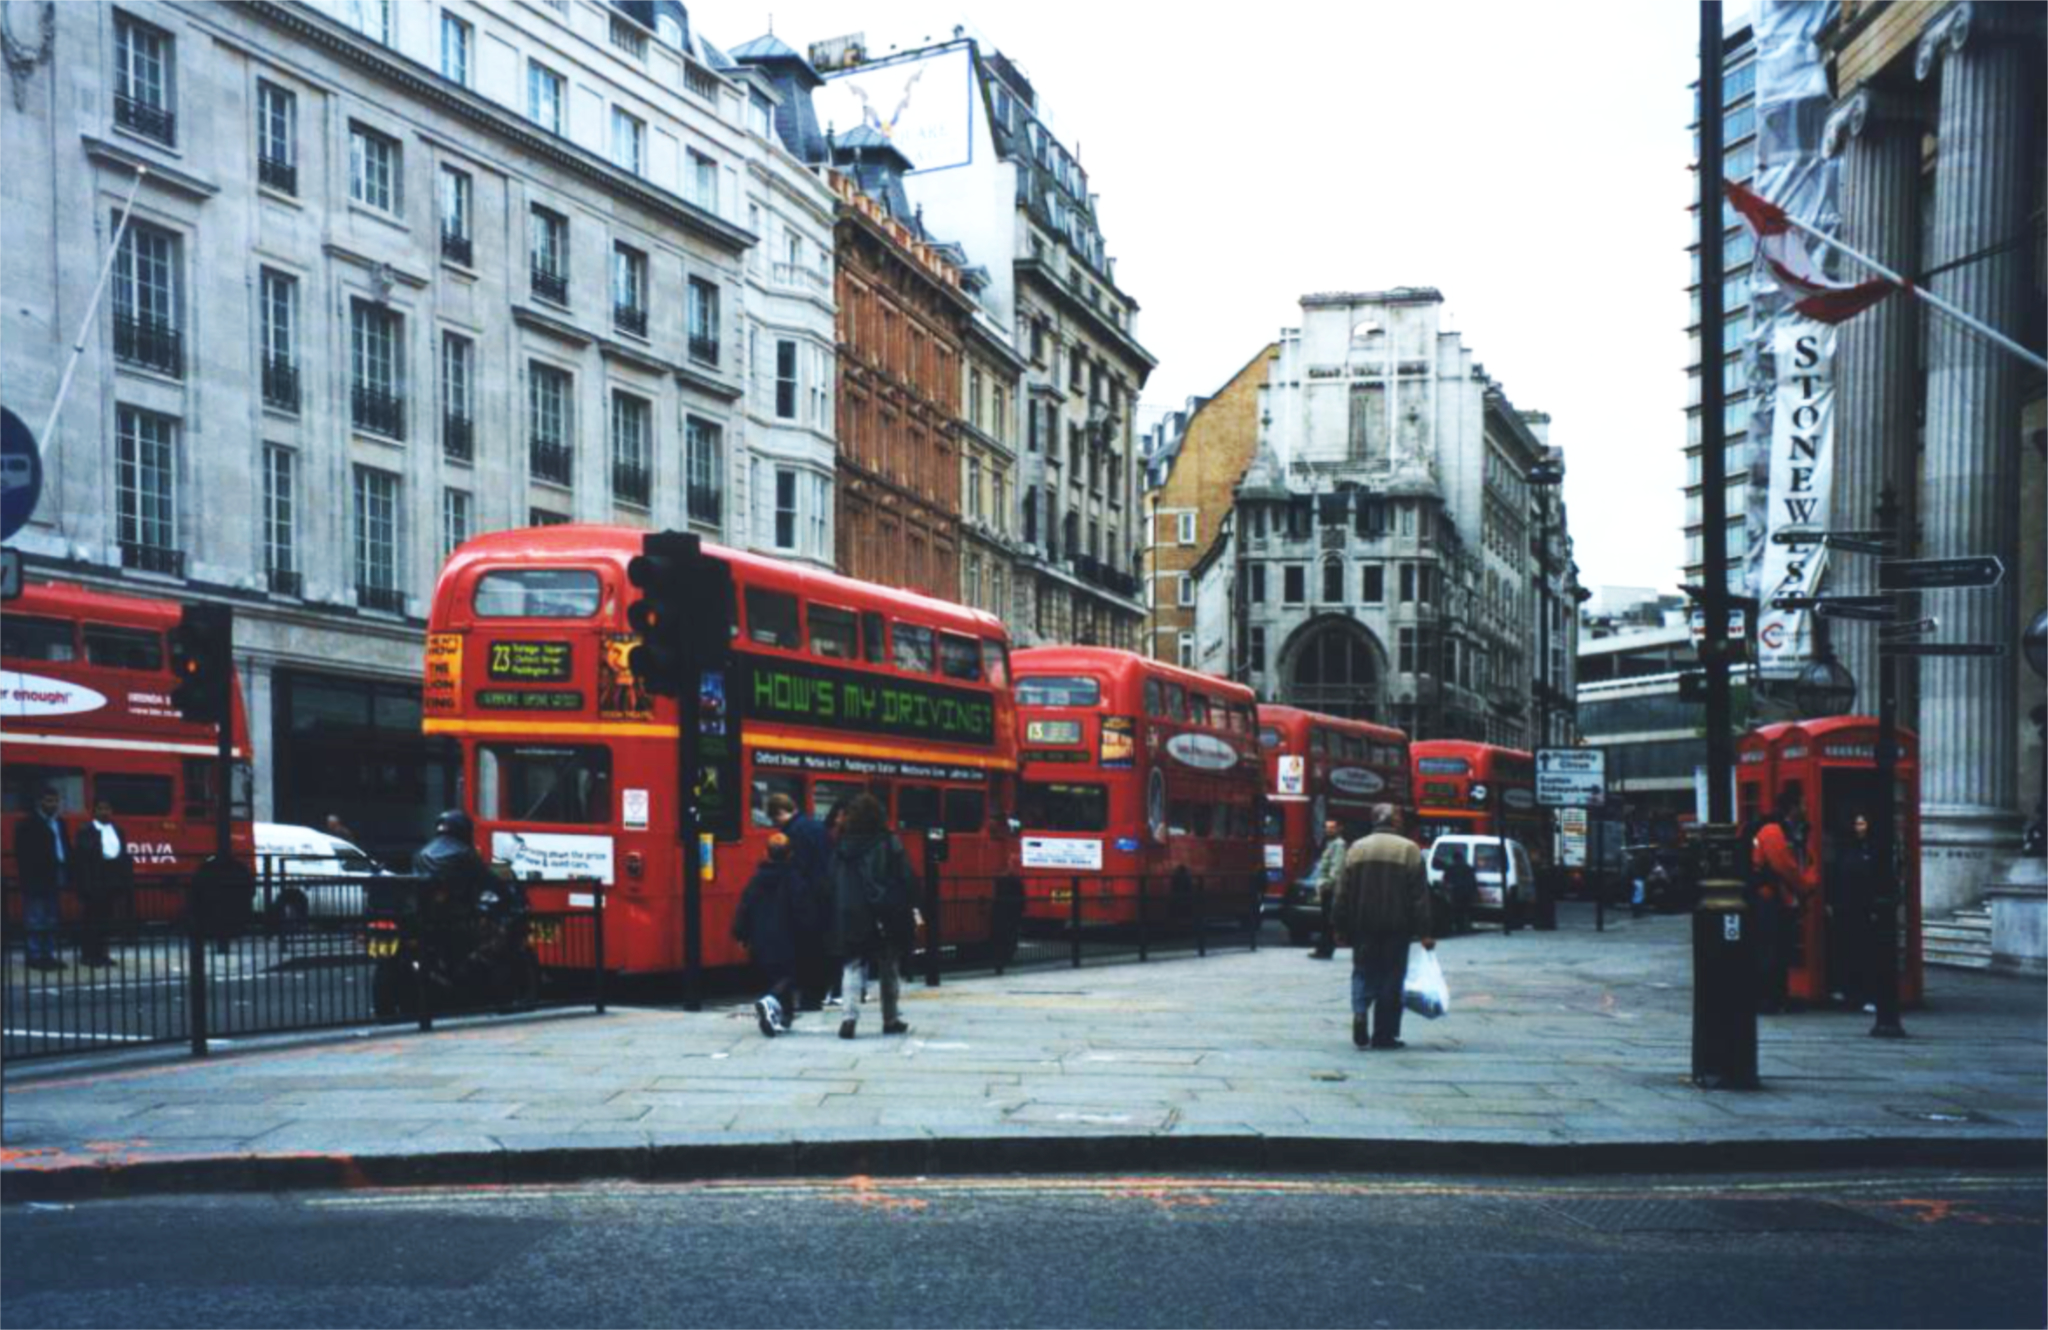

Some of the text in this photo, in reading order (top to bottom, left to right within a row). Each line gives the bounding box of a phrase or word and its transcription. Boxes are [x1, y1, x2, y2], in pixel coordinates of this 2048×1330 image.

[492, 644, 510, 672] 23
[754, 669, 834, 716] HOW'S
[843, 683, 875, 719] MY
